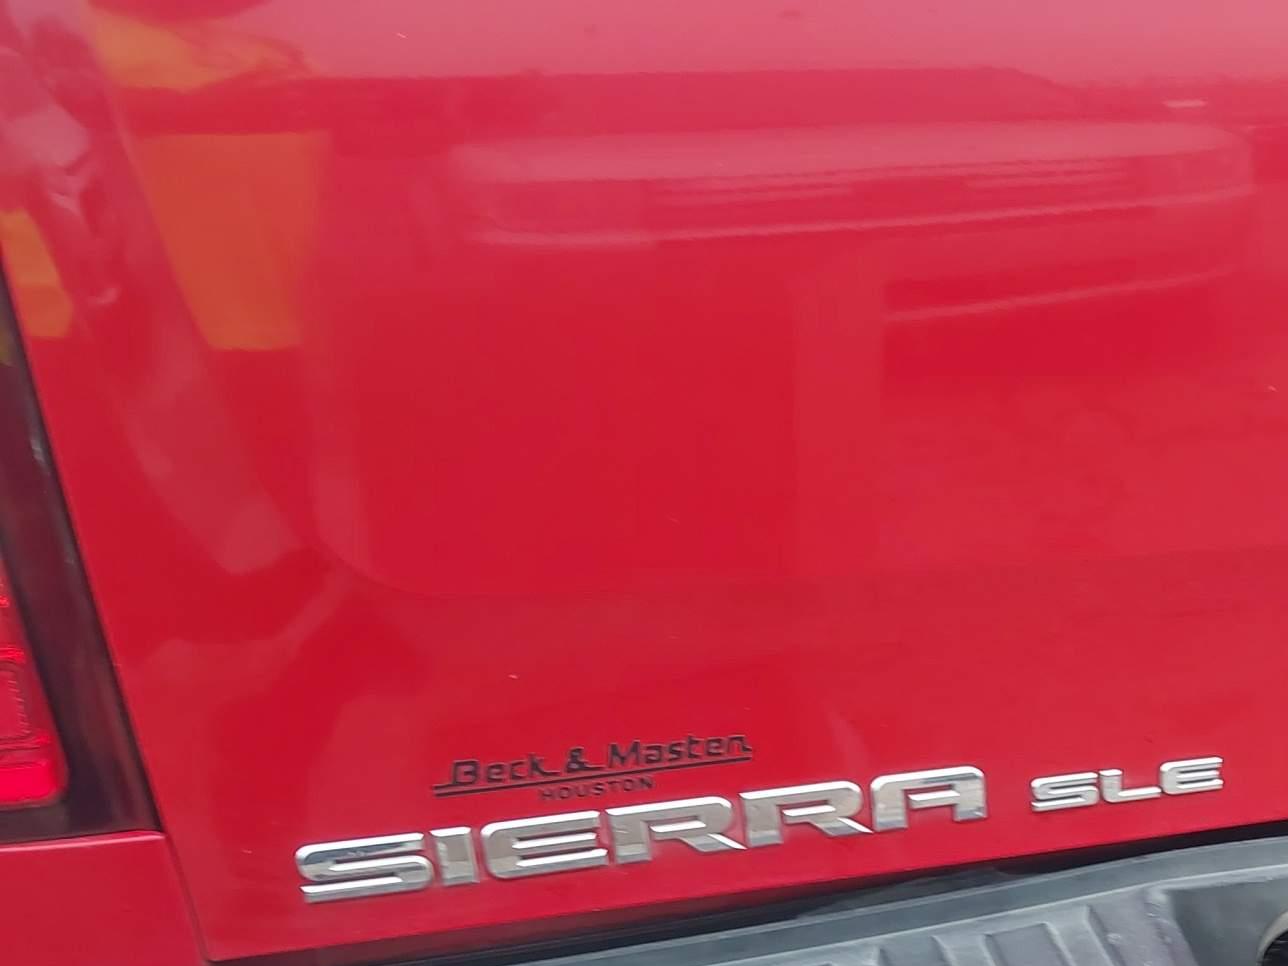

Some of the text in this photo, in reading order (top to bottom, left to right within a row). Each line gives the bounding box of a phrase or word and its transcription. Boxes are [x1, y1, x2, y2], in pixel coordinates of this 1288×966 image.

[450, 734, 752, 786] Beck & Masten
[541, 776, 657, 802] HOUSTON
[294, 756, 1224, 905] SIERRA SLE
